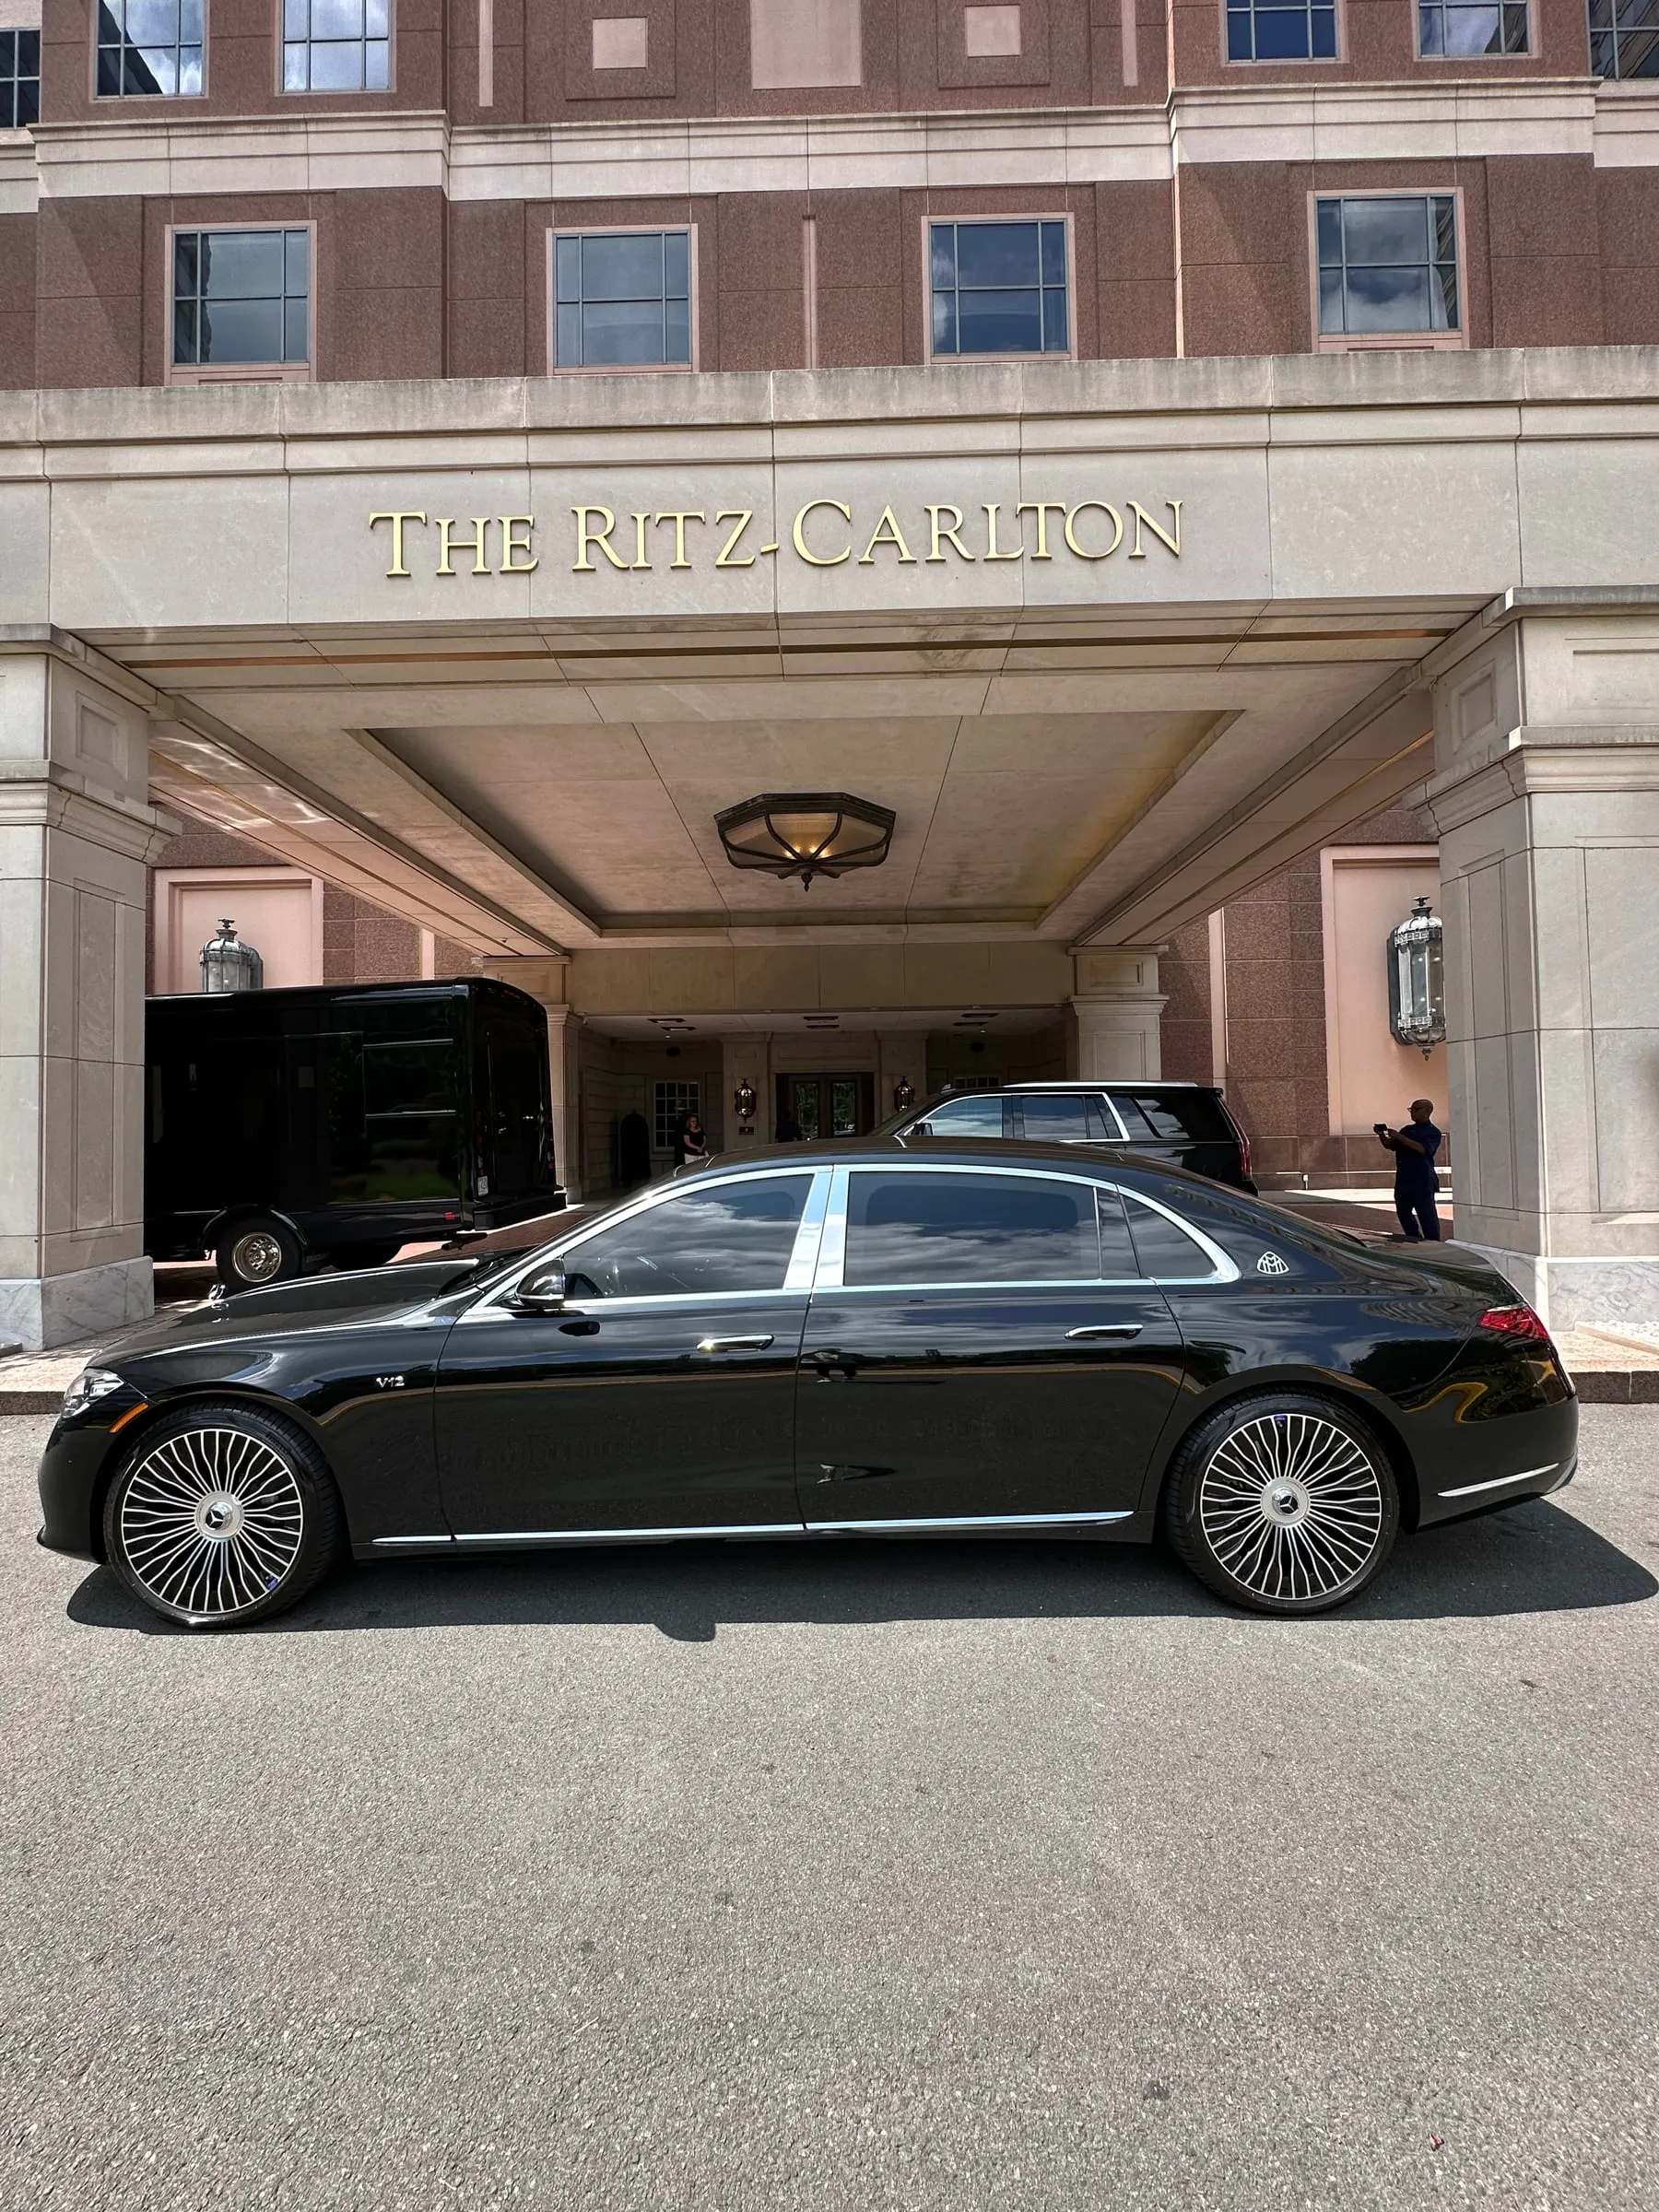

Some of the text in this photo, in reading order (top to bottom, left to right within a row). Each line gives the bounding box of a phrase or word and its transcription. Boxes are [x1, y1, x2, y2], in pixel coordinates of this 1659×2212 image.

[369, 498, 1183, 577] THE RITZ-CARLTON
[376, 1375, 405, 1388] V12
